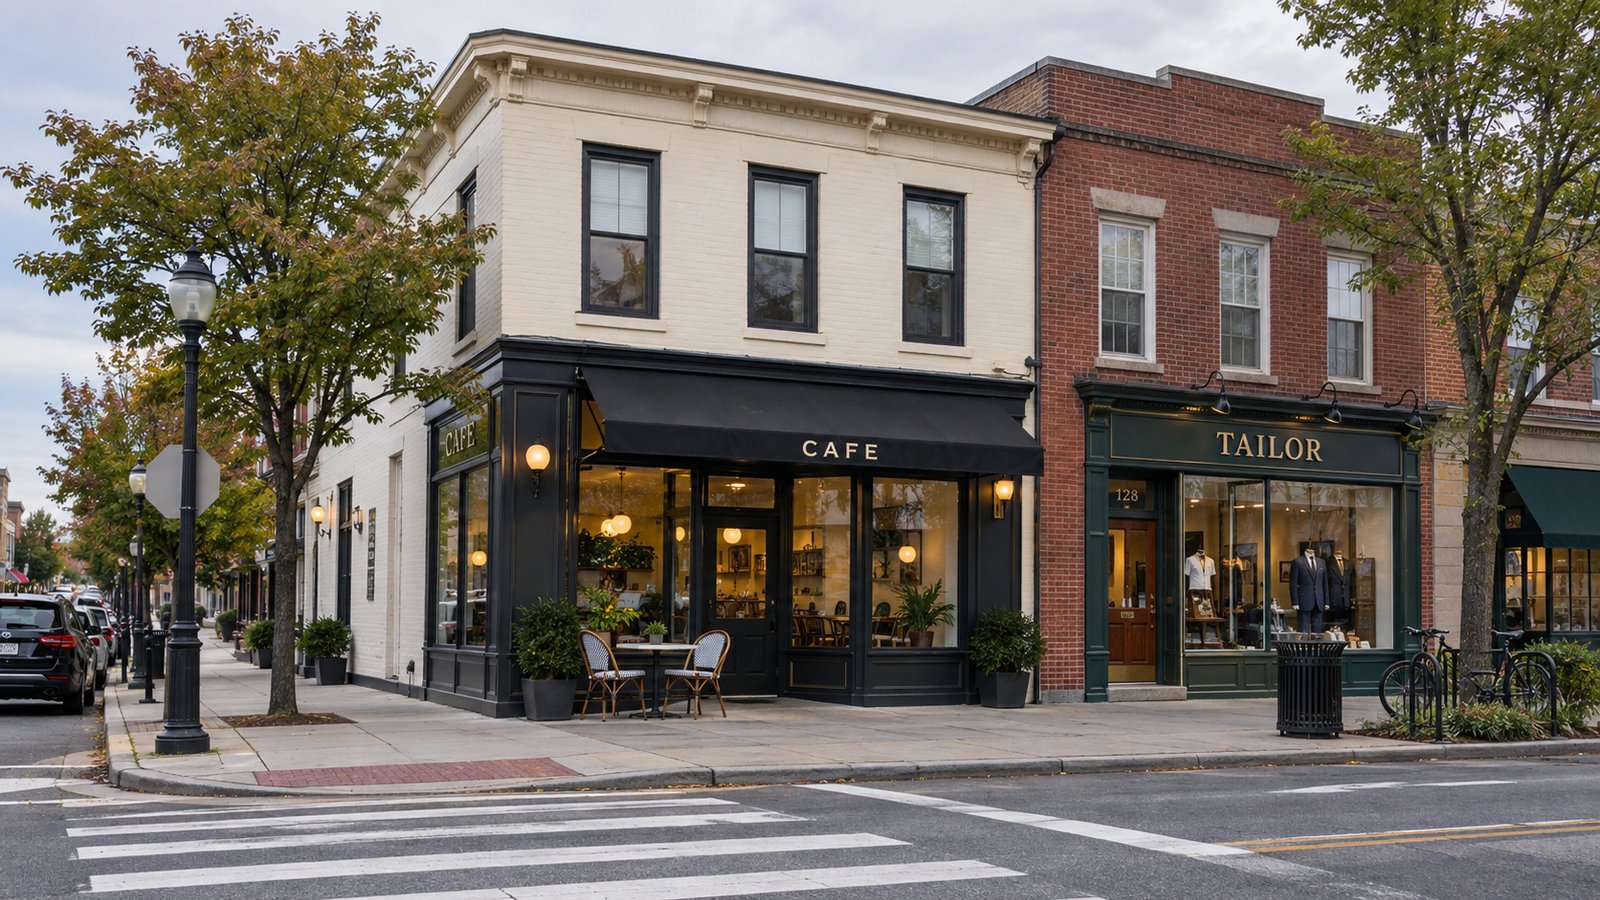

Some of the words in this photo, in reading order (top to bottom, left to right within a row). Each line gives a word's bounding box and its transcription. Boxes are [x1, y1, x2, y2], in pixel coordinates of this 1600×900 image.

[446, 421, 475, 457] CAFE
[802, 439, 878, 460] CAFE
[1216, 431, 1323, 462] TAILOR
[1115, 488, 1139, 502] 128
